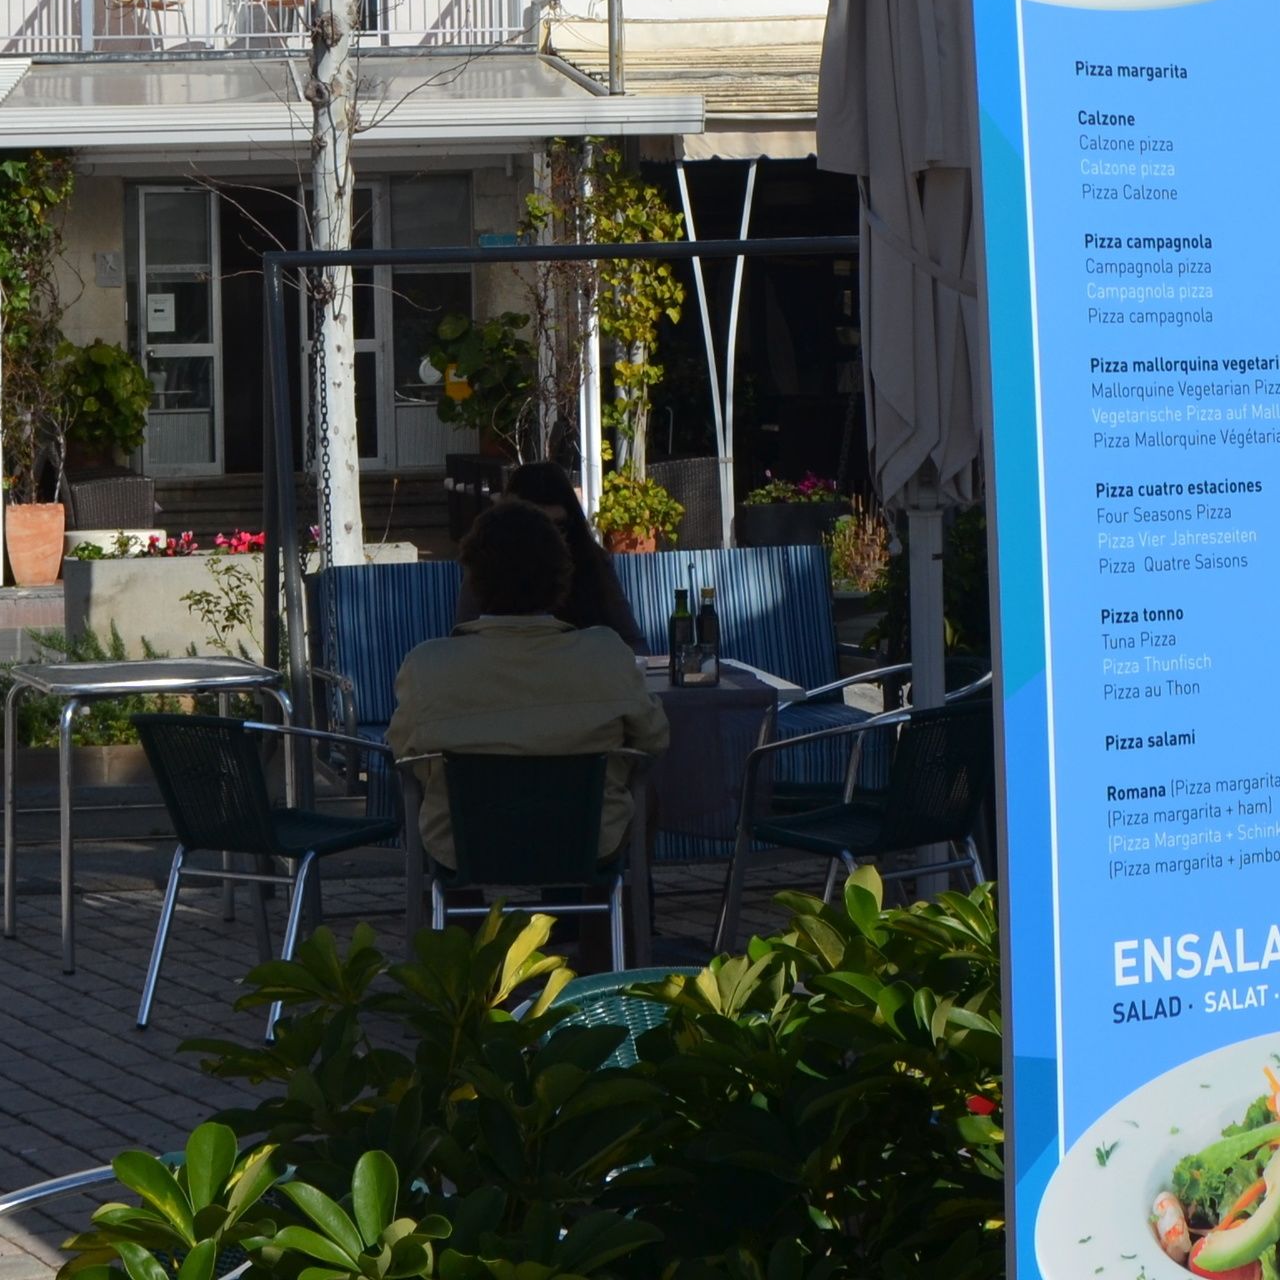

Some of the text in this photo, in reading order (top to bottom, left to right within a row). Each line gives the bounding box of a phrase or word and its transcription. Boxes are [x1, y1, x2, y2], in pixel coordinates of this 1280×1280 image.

[1076, 61, 1187, 81] Pizza margarita
[1078, 110, 1135, 126] Calzone
[1080, 134, 1173, 155] Calzone pizza
[1081, 159, 1176, 179] Calzone pizza
[1082, 184, 1177, 200] Pizza Calzone
[1085, 234, 1212, 252] Pizza campagnola
[1086, 258, 1211, 278] Campagnola pizza
[1087, 282, 1213, 303] Campagnola pizza
[1089, 307, 1213, 327] Pizza campagnola
[1091, 358, 1128, 373] Pizza
[1133, 356, 1218, 375] mallorquina
[1092, 382, 1174, 401] Mallorquine
[1178, 381, 1250, 400] Vegetarian
[1092, 406, 1182, 428] Vegetarische
[1187, 405, 1221, 421] Pizza
[1226, 404, 1247, 420] auf
[1094, 432, 1129, 448] Pizza
[1135, 432, 1216, 450] Mallorquine
[1096, 480, 1262, 498] Pizza cuatro estaciones
[1097, 504, 1231, 523] Four Seasons Pizza
[1098, 529, 1257, 549] Pizza Vier Jahreszeiten
[1100, 554, 1248, 574] Pizza Quatre Saisons
[1101, 608, 1183, 624] Pizza tonno
[1102, 632, 1176, 650] Tuna Pizza
[1103, 654, 1211, 675] Pizza Thunfisch
[1104, 680, 1199, 700] Pizza au Thon
[1106, 729, 1195, 751] Pizza salami
[1107, 786, 1165, 801] Romana
[1171, 779, 1210, 797] (Pizza
[1216, 774, 1280, 794] margarita
[1108, 796, 1271, 828] (Pizza margarita + ham)
[1109, 835, 1151, 853] (Pizza
[1155, 829, 1222, 850] Margarita
[1226, 832, 1233, 840] +
[1110, 860, 1150, 879] (Pizza
[1156, 854, 1222, 875] margarita
[1228, 856, 1234, 864] +
[1113, 996, 1181, 1024] SALAD
[1204, 984, 1268, 1013] SALAT
